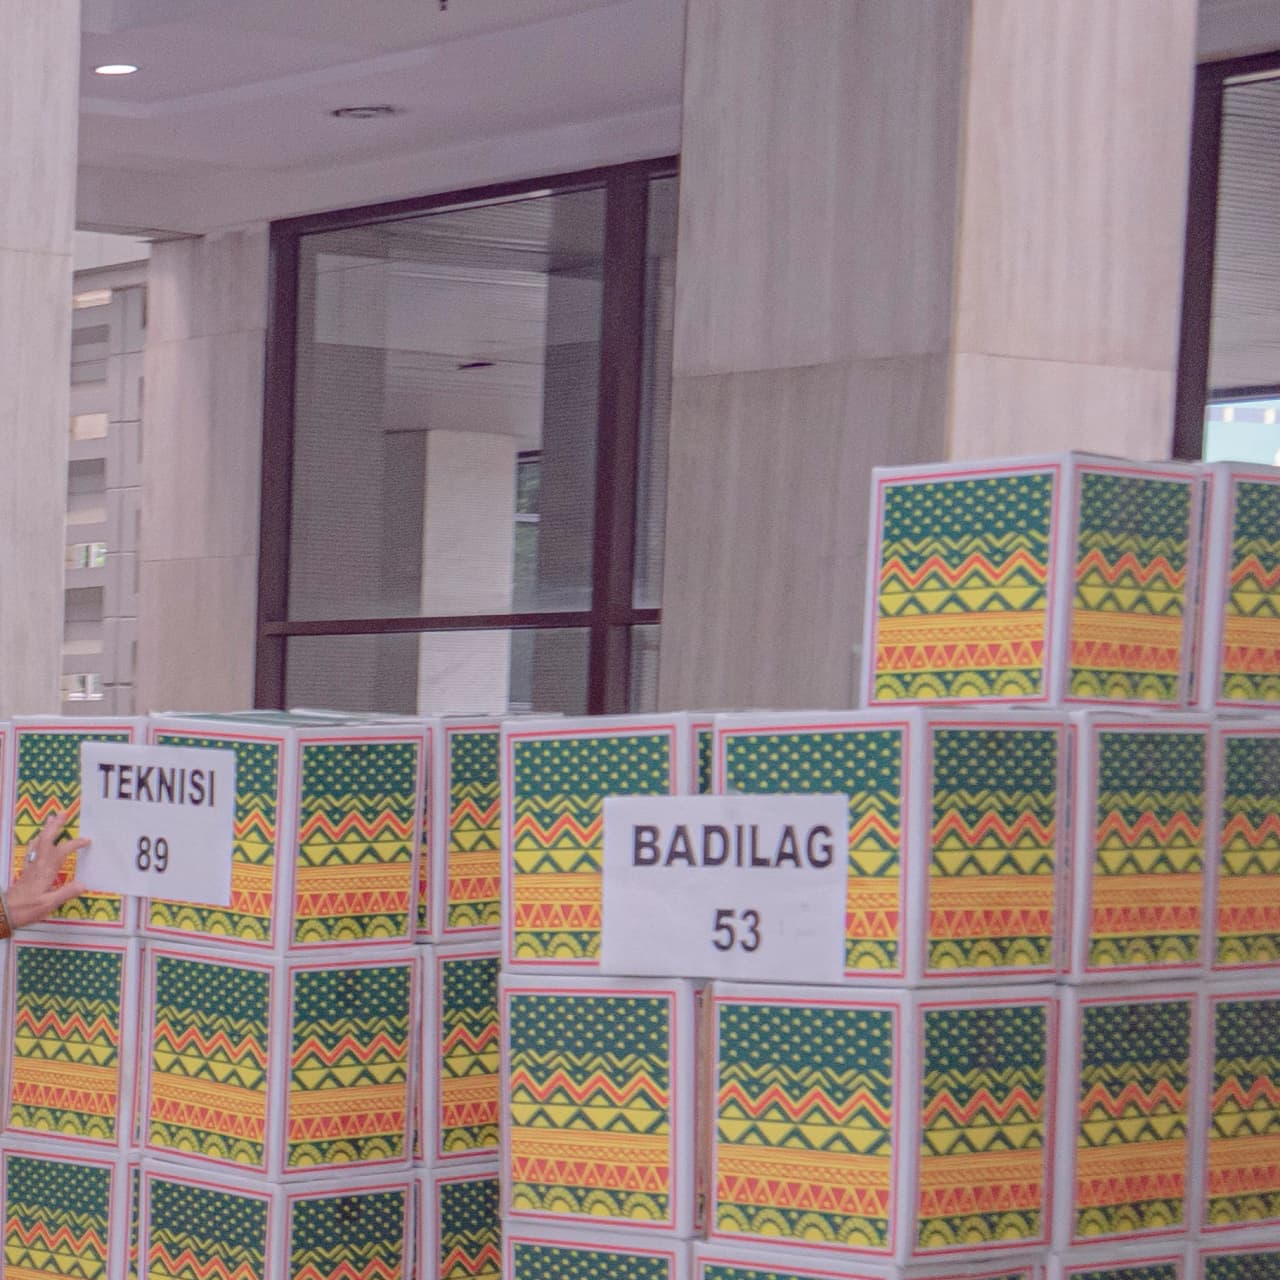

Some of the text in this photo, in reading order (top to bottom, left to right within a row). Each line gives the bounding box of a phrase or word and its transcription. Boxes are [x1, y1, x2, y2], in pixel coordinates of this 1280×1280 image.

[98, 763, 215, 807] TEKNISI
[137, 836, 169, 872] 89
[632, 824, 835, 869] BADILAG
[712, 909, 761, 952] 53
